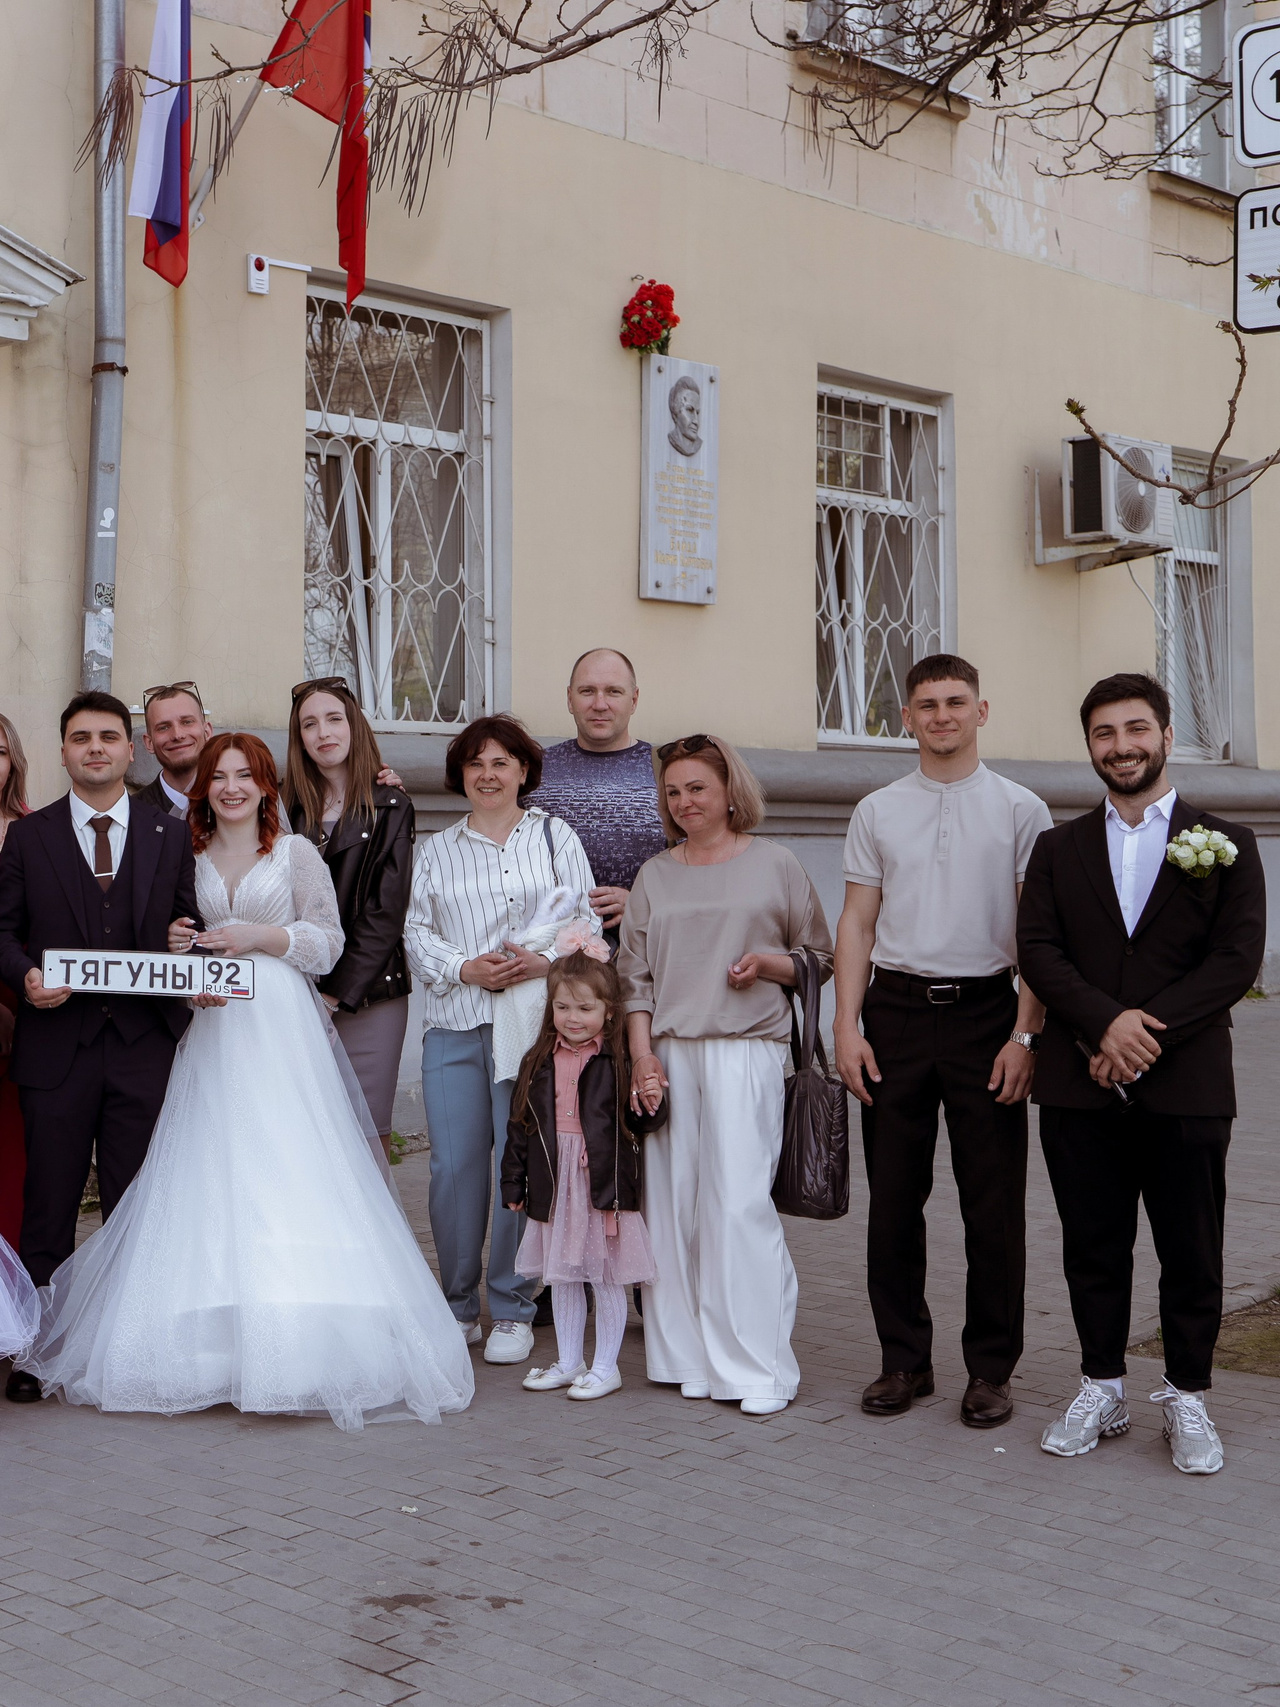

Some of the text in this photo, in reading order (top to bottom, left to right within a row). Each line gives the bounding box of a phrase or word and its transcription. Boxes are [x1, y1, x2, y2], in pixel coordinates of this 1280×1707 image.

[59, 958, 241, 990] ТЯГУНЫ 92
[205, 984, 231, 994] RUS
